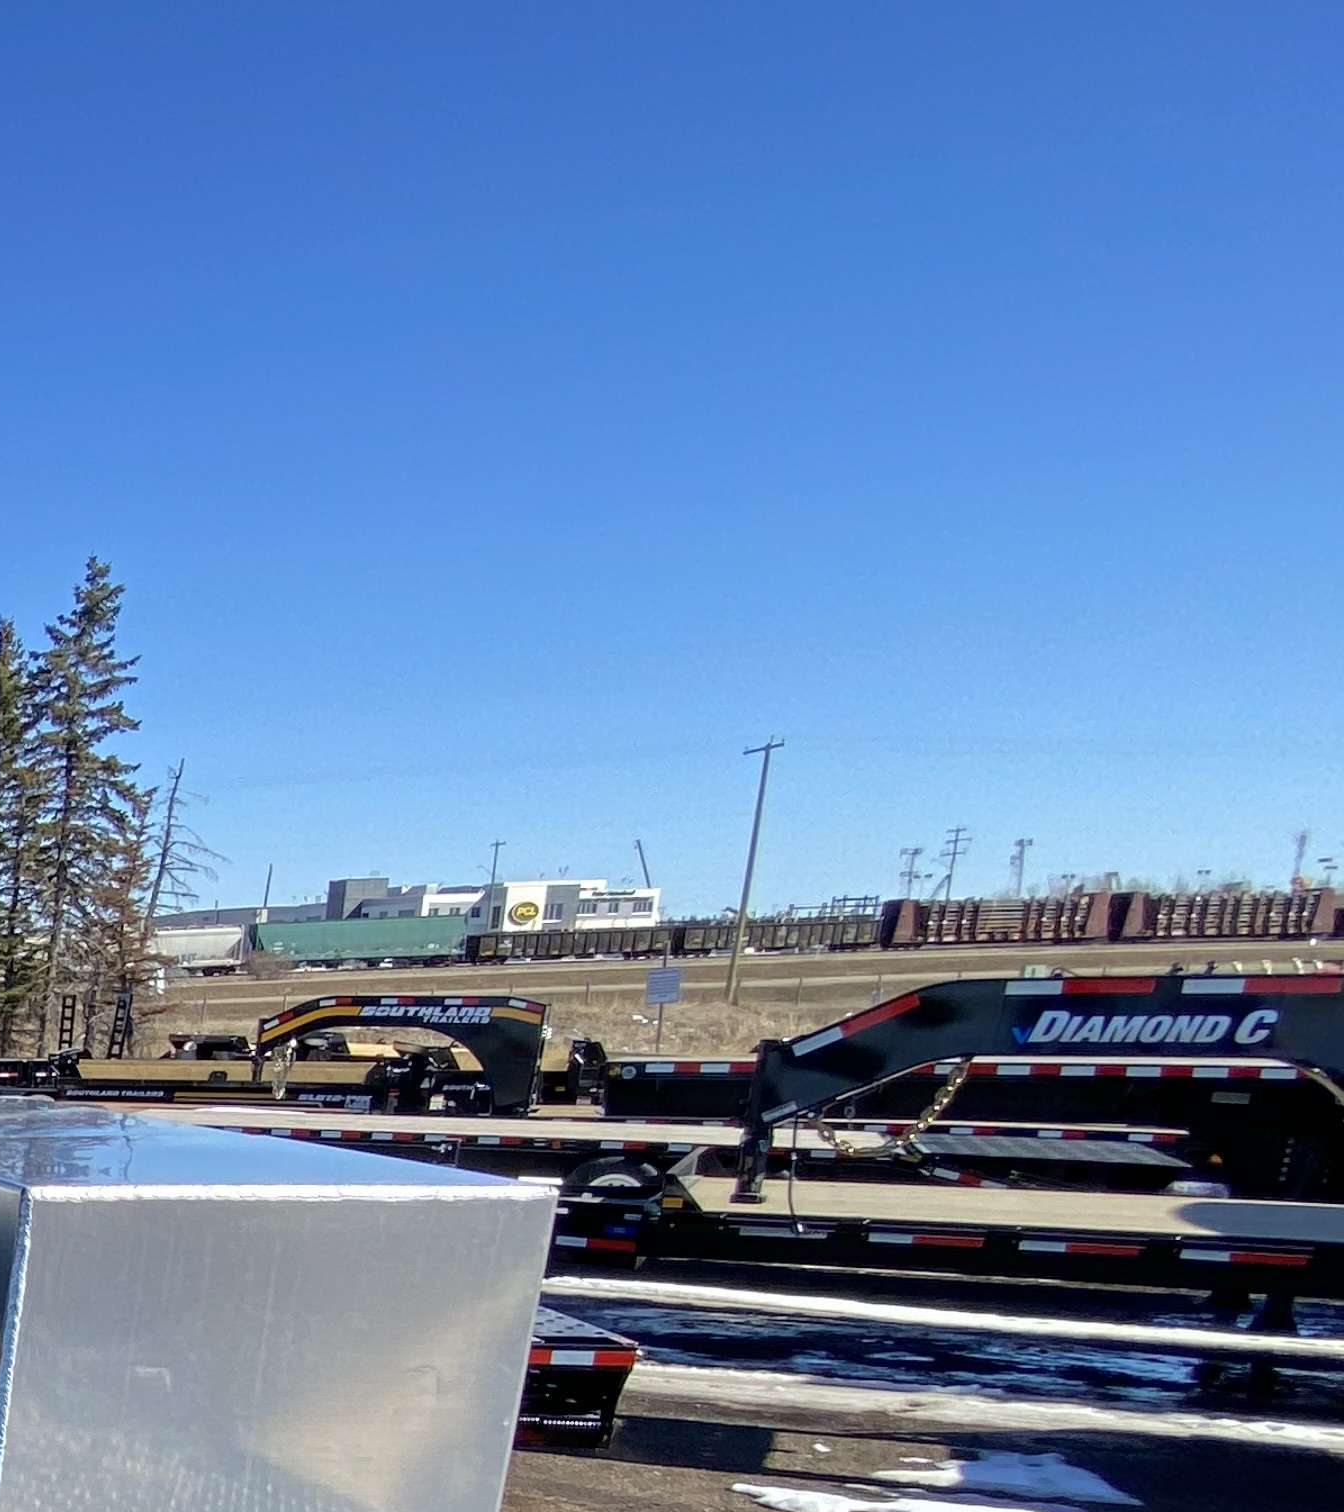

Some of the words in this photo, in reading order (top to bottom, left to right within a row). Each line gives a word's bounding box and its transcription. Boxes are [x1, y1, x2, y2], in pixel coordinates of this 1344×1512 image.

[359, 1006, 492, 1017] SOUTHLAND
[423, 1016, 491, 1024] TRAILERS
[1027, 1010, 1232, 1043] DIAMOND
[1234, 1010, 1278, 1044] C
